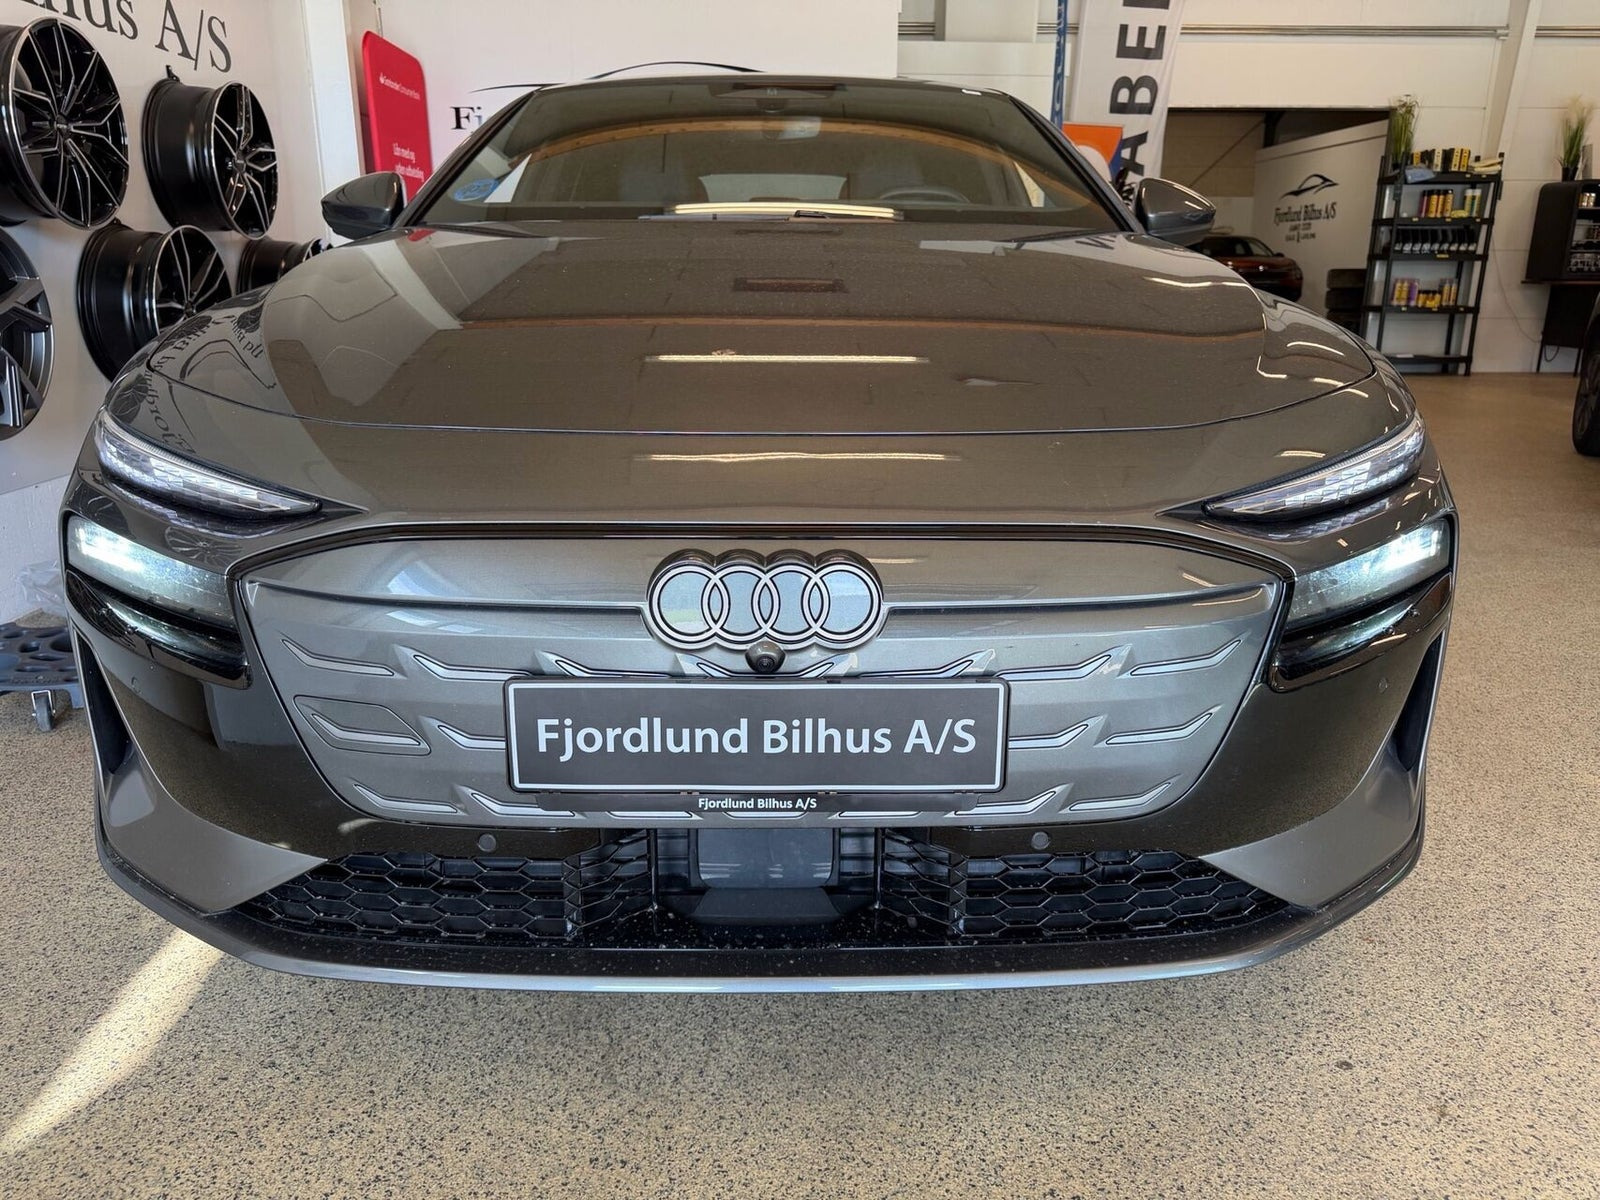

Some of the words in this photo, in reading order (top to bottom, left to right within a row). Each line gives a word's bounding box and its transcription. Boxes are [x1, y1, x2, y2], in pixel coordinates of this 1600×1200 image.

[155, 0, 232, 73] A/S
[1109, 0, 1170, 177] ABE
[536, 717, 748, 762] Fjordlund
[763, 718, 892, 754] Bilhus
[903, 718, 977, 755] A/S
[698, 798, 754, 810] Fjordlund
[757, 798, 793, 809] Bilhus
[795, 797, 817, 810] A/S
